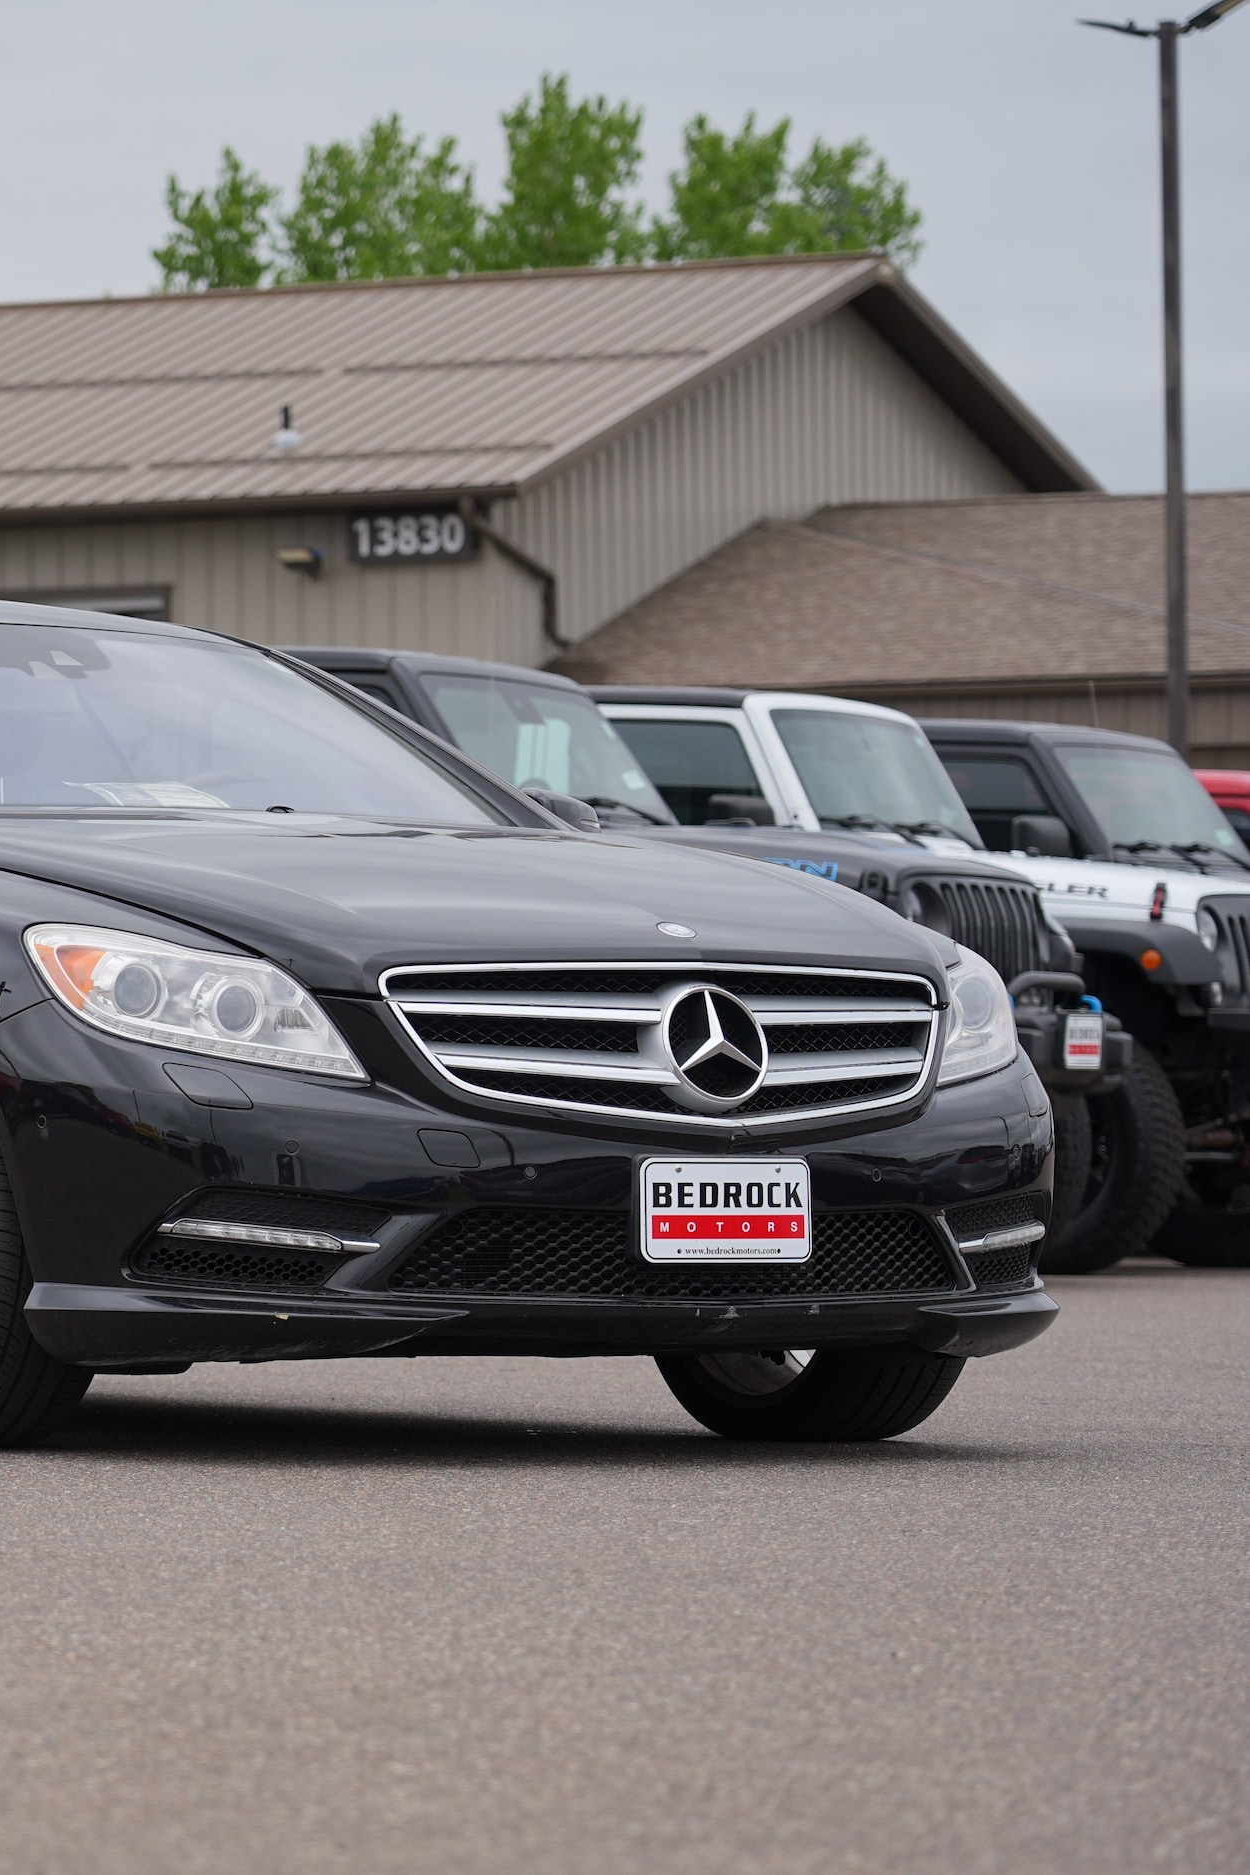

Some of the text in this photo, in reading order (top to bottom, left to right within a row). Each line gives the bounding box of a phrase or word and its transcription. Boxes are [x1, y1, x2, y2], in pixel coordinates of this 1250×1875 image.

[351, 513, 466, 558] 13830
[652, 1182, 803, 1208] BEDROCK
[660, 1222, 799, 1233] MOTORS
[685, 1246, 777, 1256] www.bedrockmotors.com
